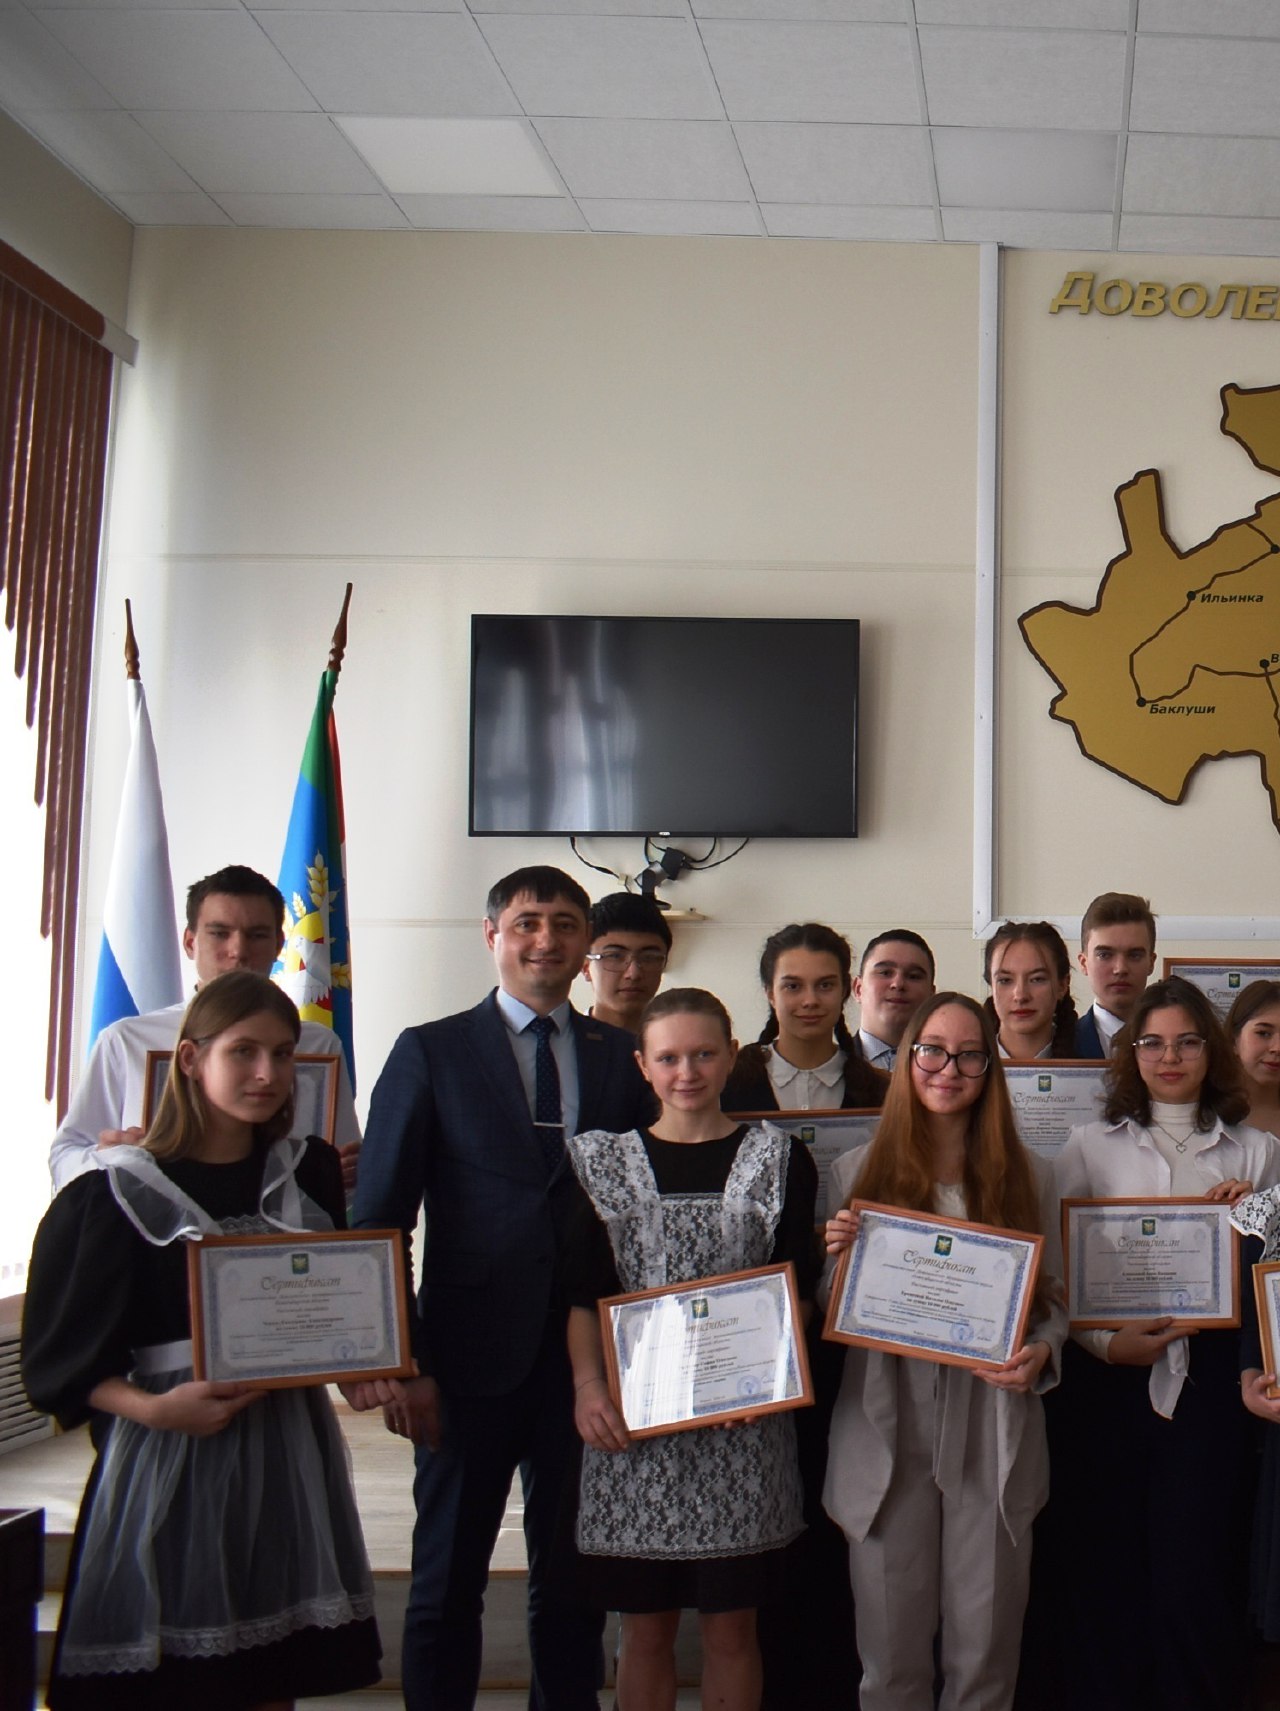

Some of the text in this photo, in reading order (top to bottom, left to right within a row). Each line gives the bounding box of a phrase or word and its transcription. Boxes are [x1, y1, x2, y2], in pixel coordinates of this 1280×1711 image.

[1200, 593, 1264, 603] Ильинка
[1149, 703, 1216, 716] Баклуши
[903, 1249, 977, 1275] Сертификат
